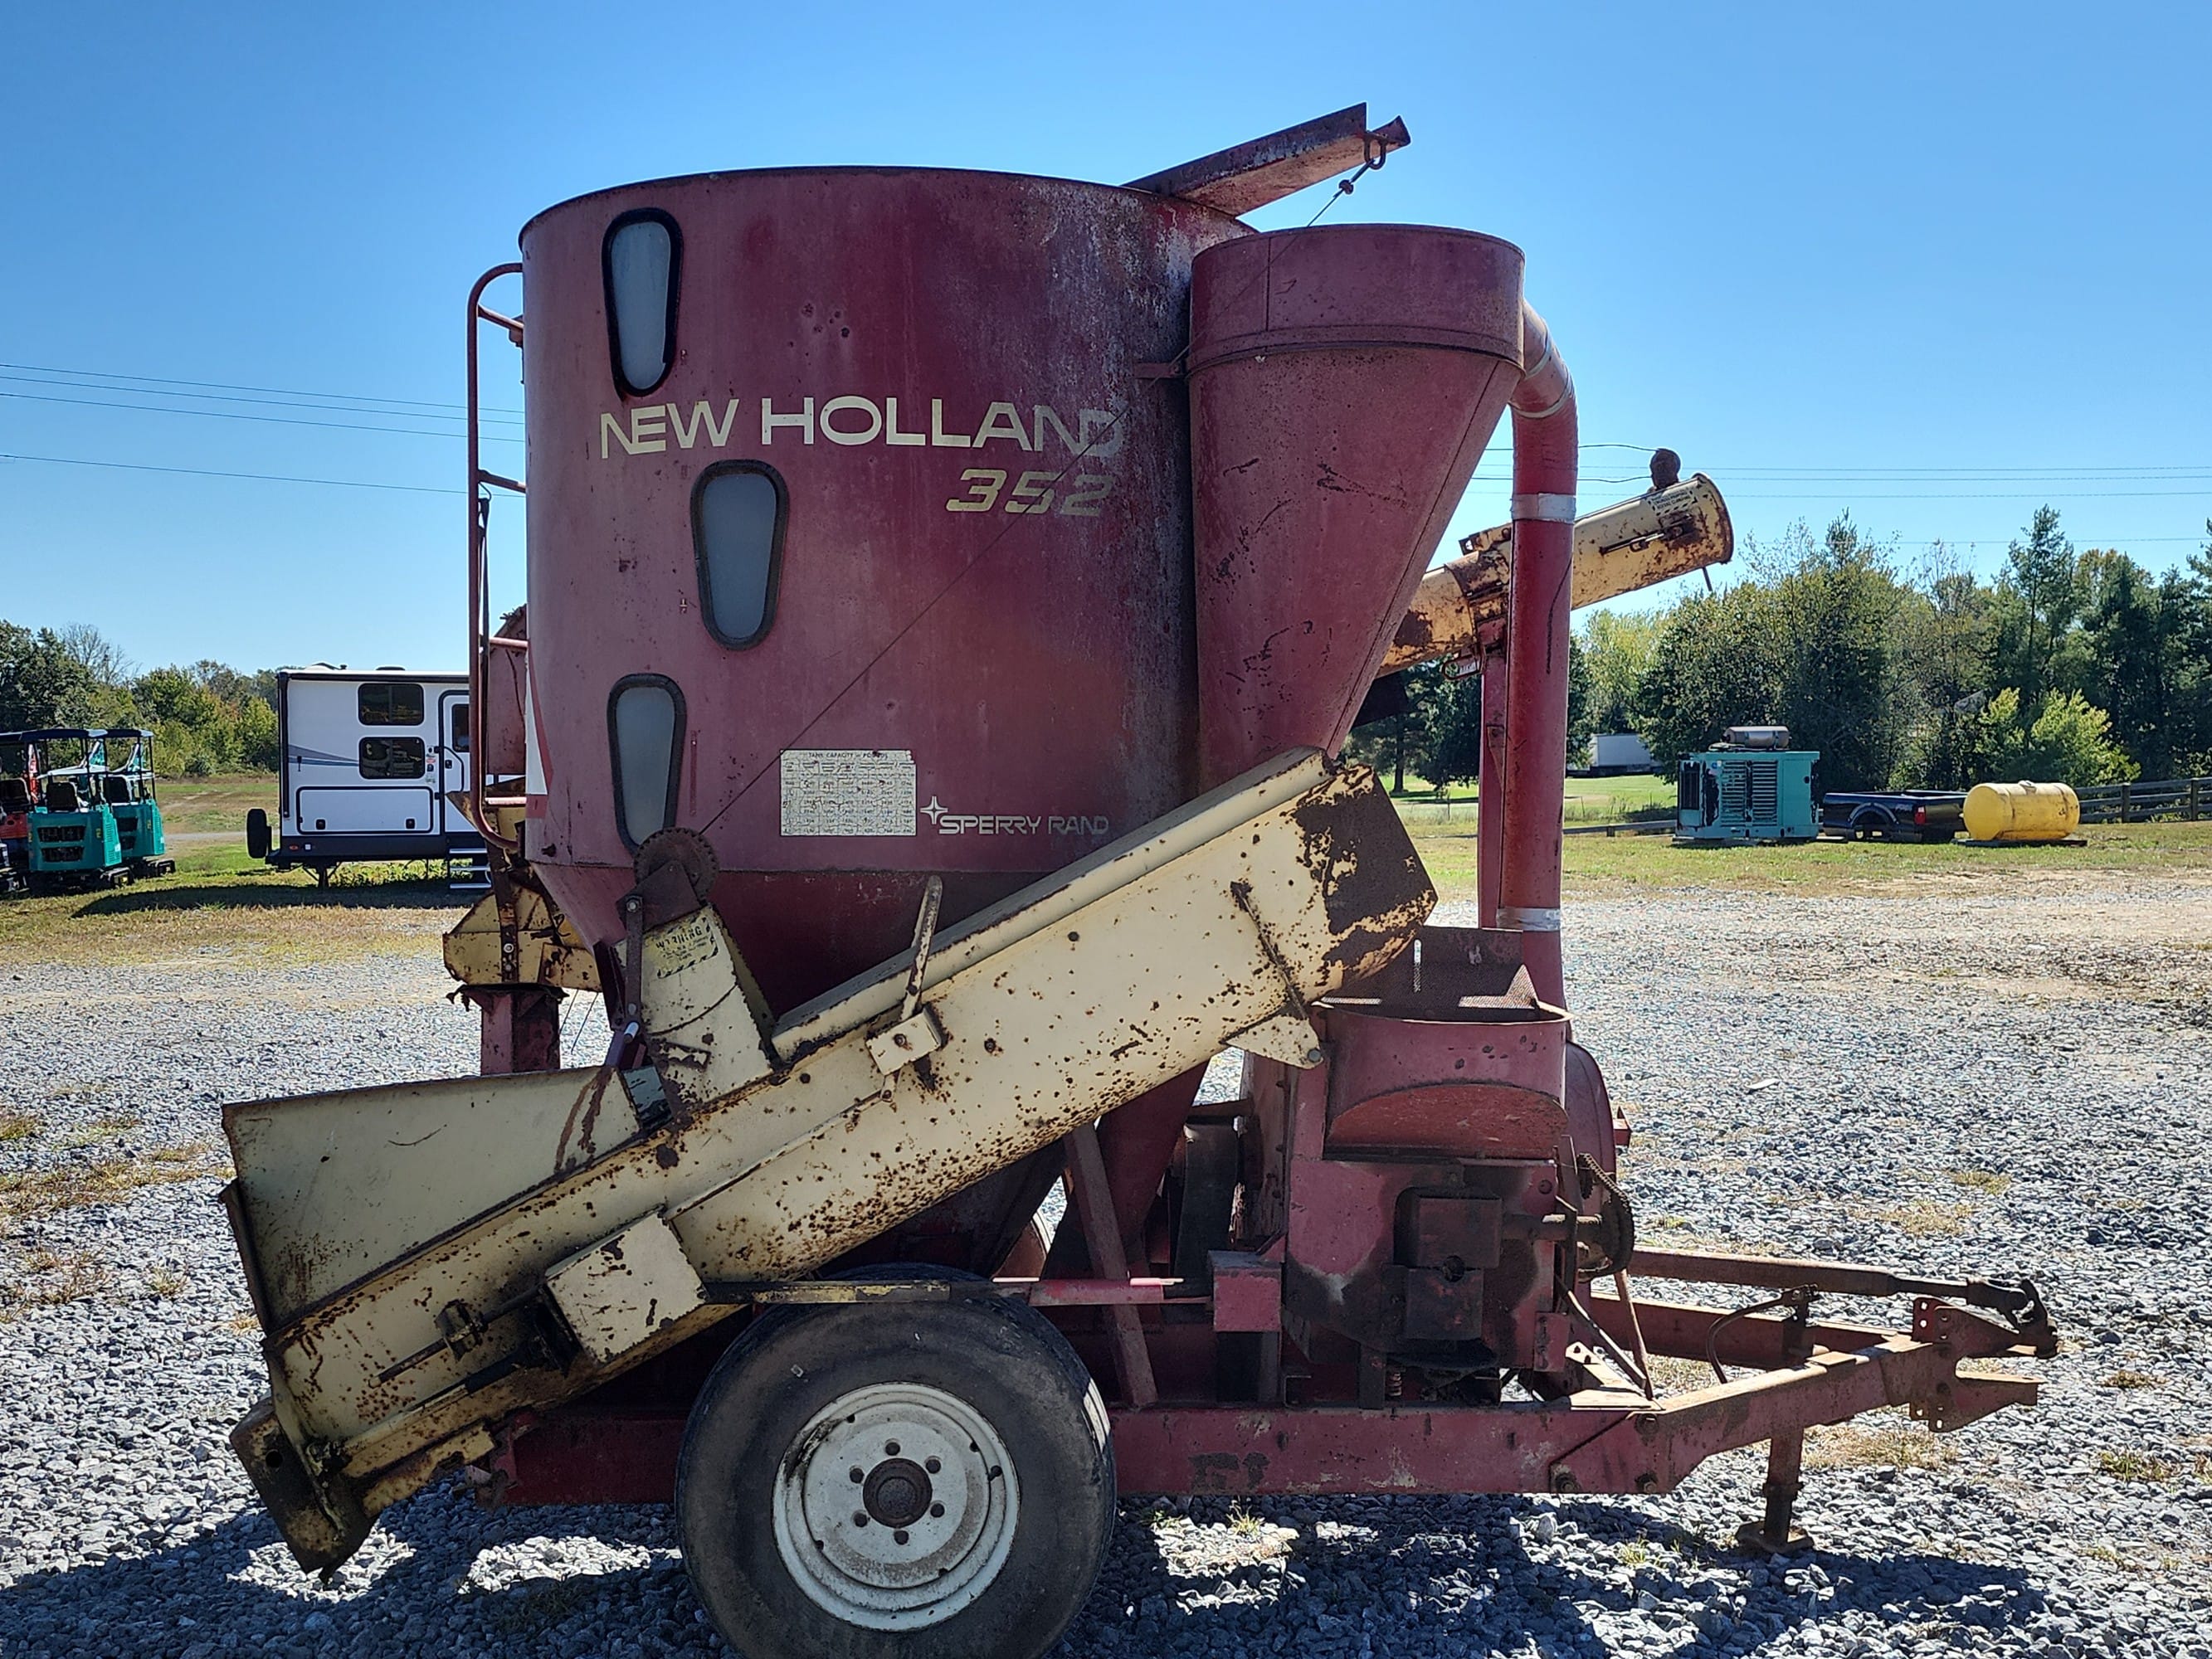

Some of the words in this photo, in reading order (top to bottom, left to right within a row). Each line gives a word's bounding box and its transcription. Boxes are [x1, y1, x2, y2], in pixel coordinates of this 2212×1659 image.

[600, 398, 739, 460] NEW
[761, 395, 1125, 459] HOLLAND
[945, 468, 1115, 516] 352
[938, 815, 1042, 834] SPERRY
[1048, 815, 1109, 835] RAND
